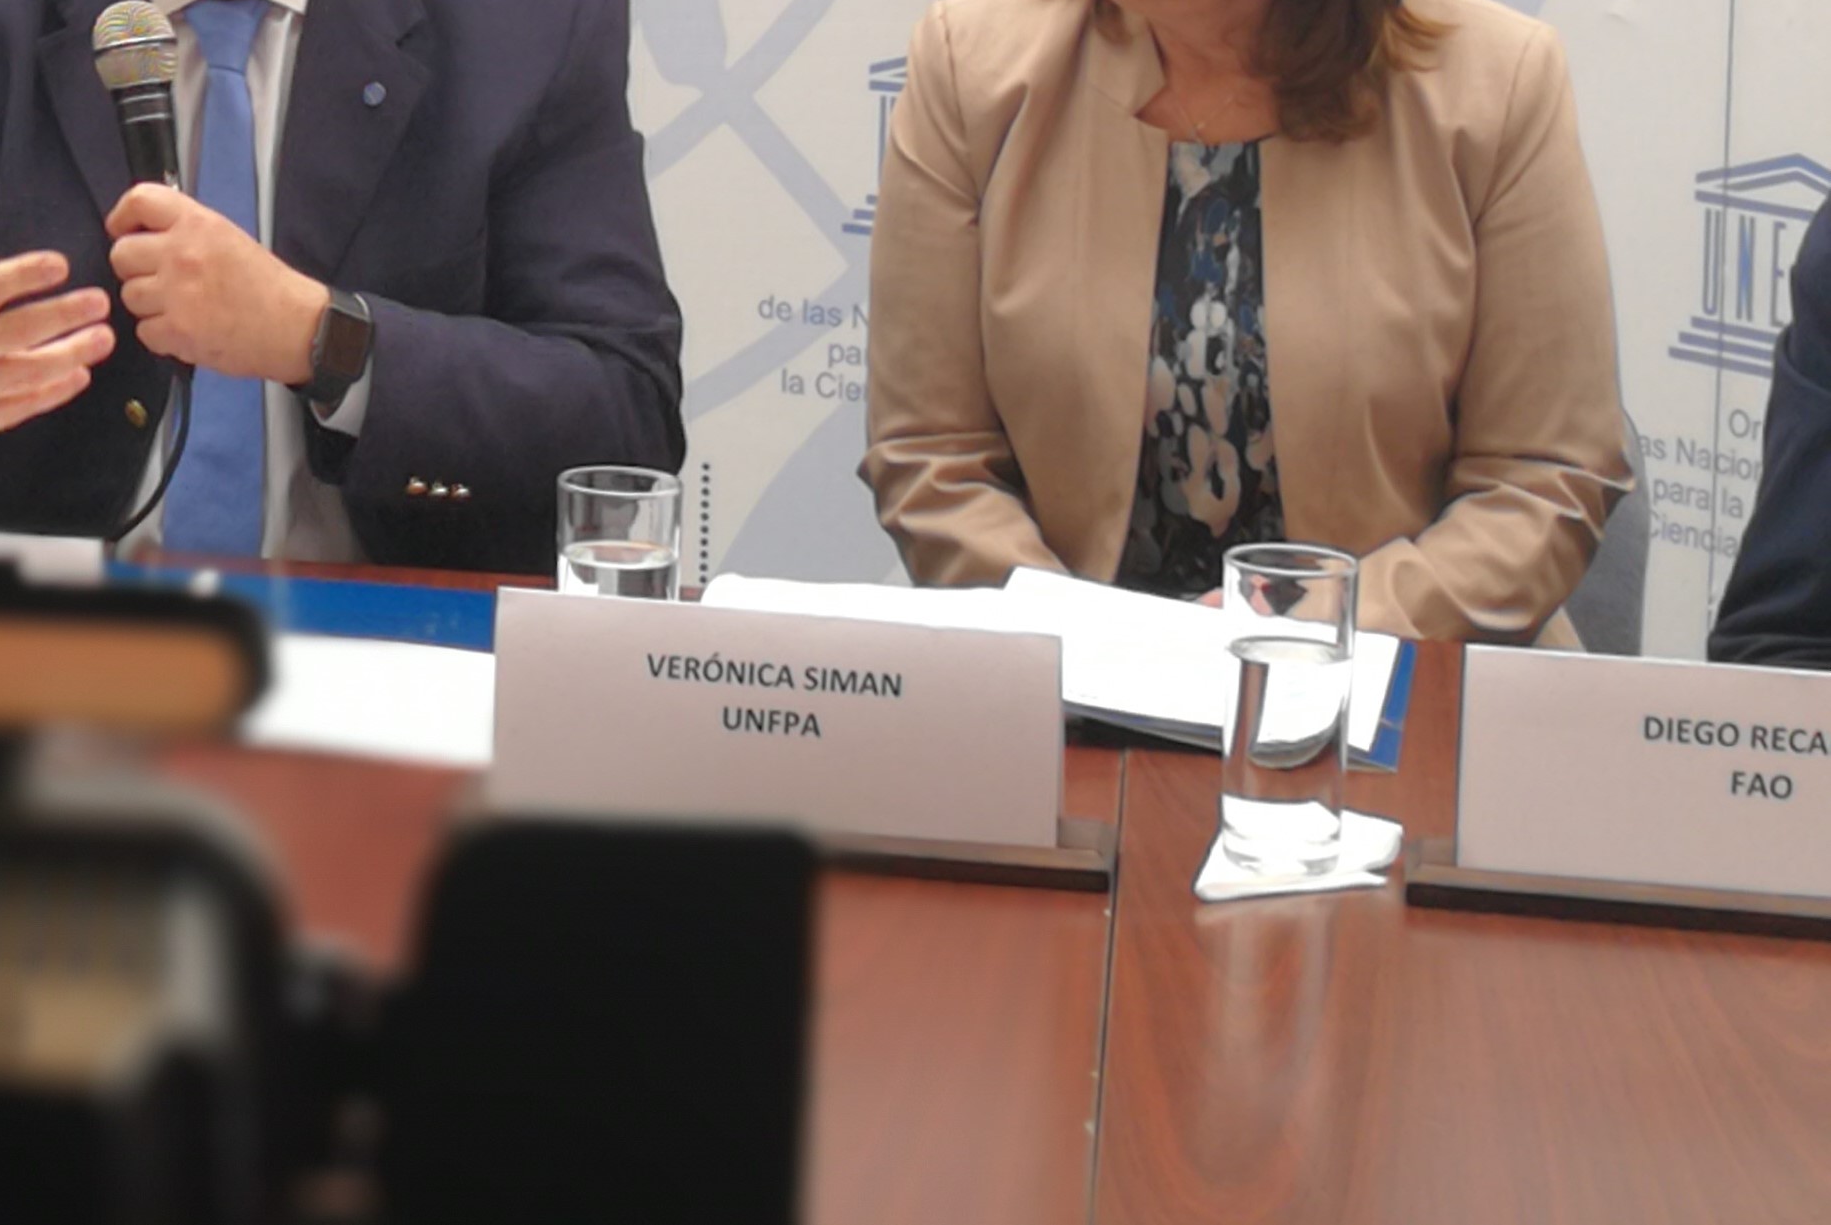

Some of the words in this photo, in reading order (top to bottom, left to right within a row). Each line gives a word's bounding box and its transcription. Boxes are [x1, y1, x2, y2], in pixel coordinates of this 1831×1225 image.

[1704, 208, 1787, 328] UNE
[758, 294, 791, 322] de
[802, 298, 841, 327] las
[828, 343, 862, 368] pa
[782, 368, 804, 394] la
[1638, 435, 1667, 460] as
[1653, 478, 1711, 511] para
[1721, 488, 1744, 518] la
[647, 652, 795, 689] VERÓNICA
[803, 666, 903, 697] SIMAN
[723, 706, 821, 738] UNFPA
[1644, 716, 1740, 747] DIEGO
[1731, 771, 1793, 799] FAO
